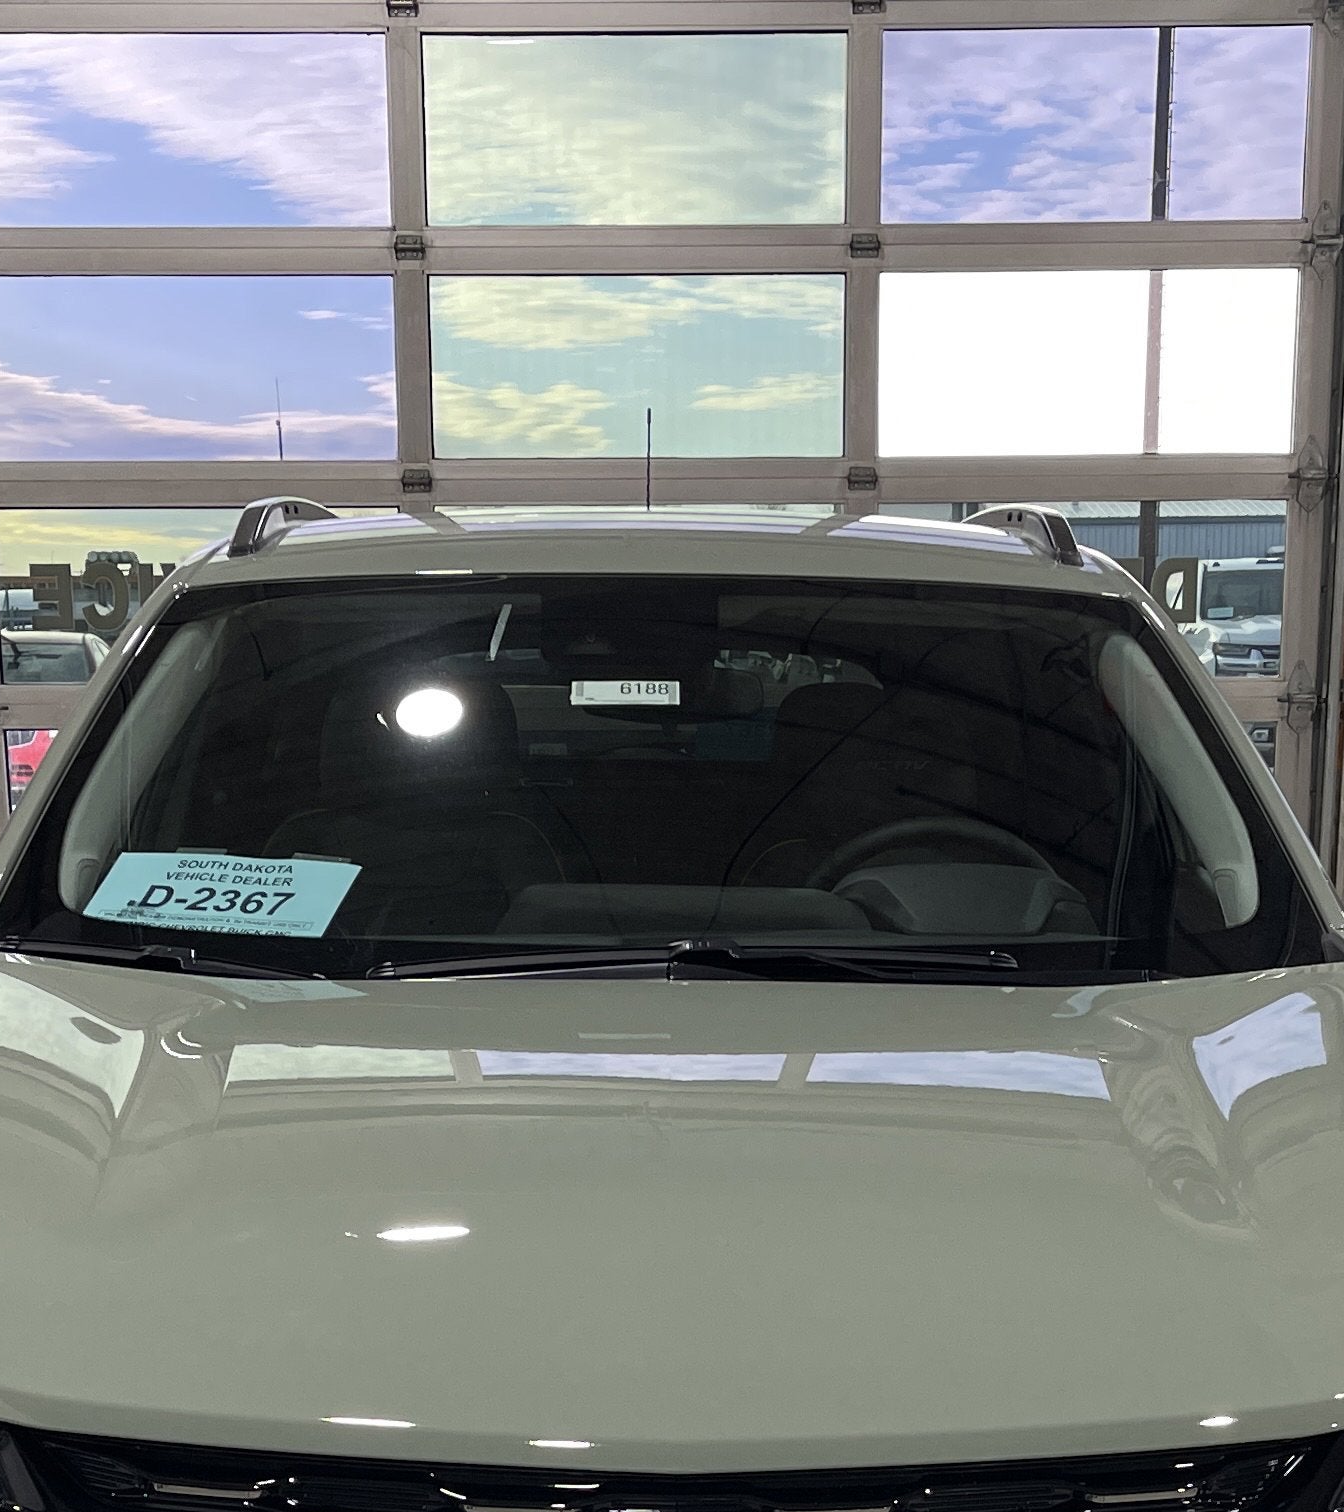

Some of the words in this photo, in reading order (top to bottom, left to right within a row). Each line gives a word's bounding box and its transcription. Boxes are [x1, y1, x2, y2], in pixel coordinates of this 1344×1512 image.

[620, 682, 669, 695] 6188
[177, 859, 228, 870] SOUTH
[232, 862, 293, 874] DAKOTA
[166, 871, 228, 883] VEHICLE
[232, 875, 294, 887] DEALER
[137, 884, 296, 916] D-2367
